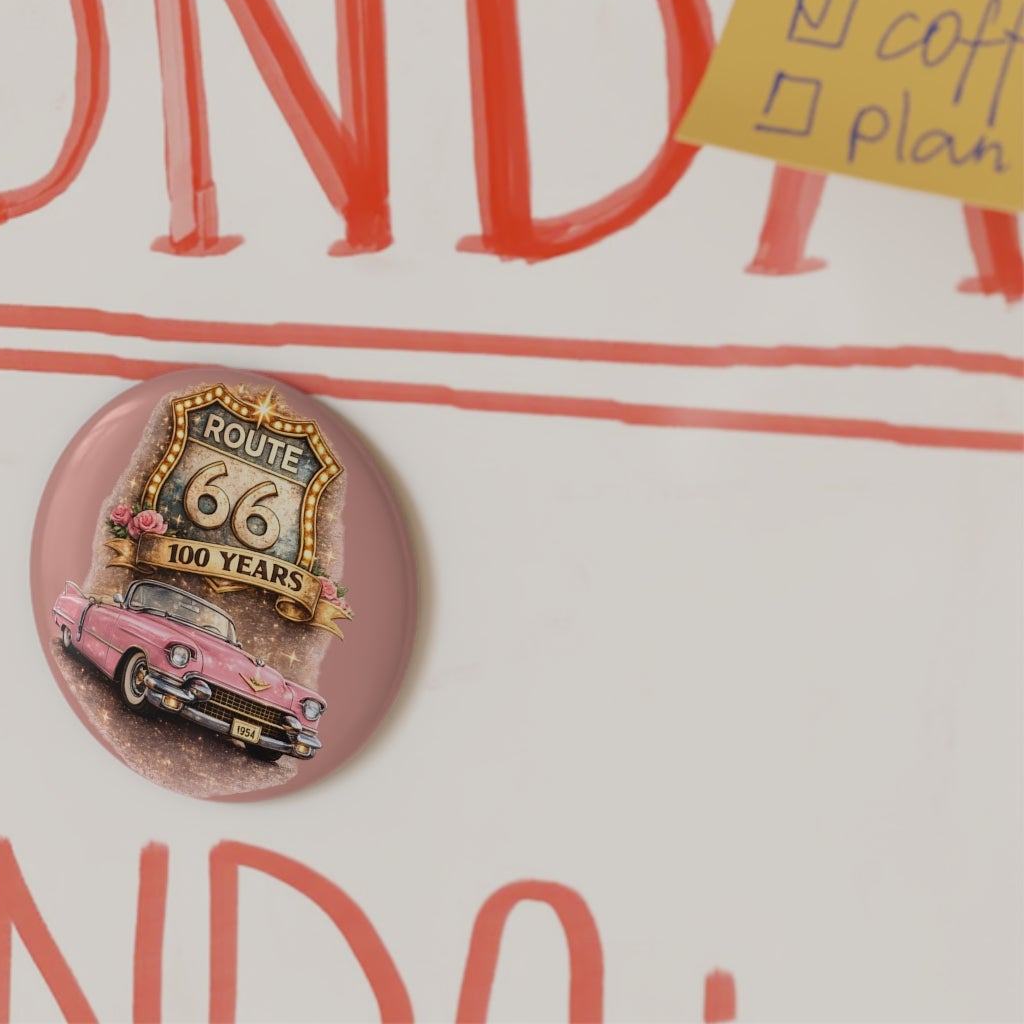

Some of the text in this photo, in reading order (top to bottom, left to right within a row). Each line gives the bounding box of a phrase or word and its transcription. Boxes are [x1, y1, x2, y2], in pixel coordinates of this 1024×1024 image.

[847, 88, 1010, 174] plan
[203, 413, 304, 474] ROUTE
[183, 460, 281, 550] 66
[167, 543, 304, 592] 100 YEARS
[236, 725, 256, 740] 1954
